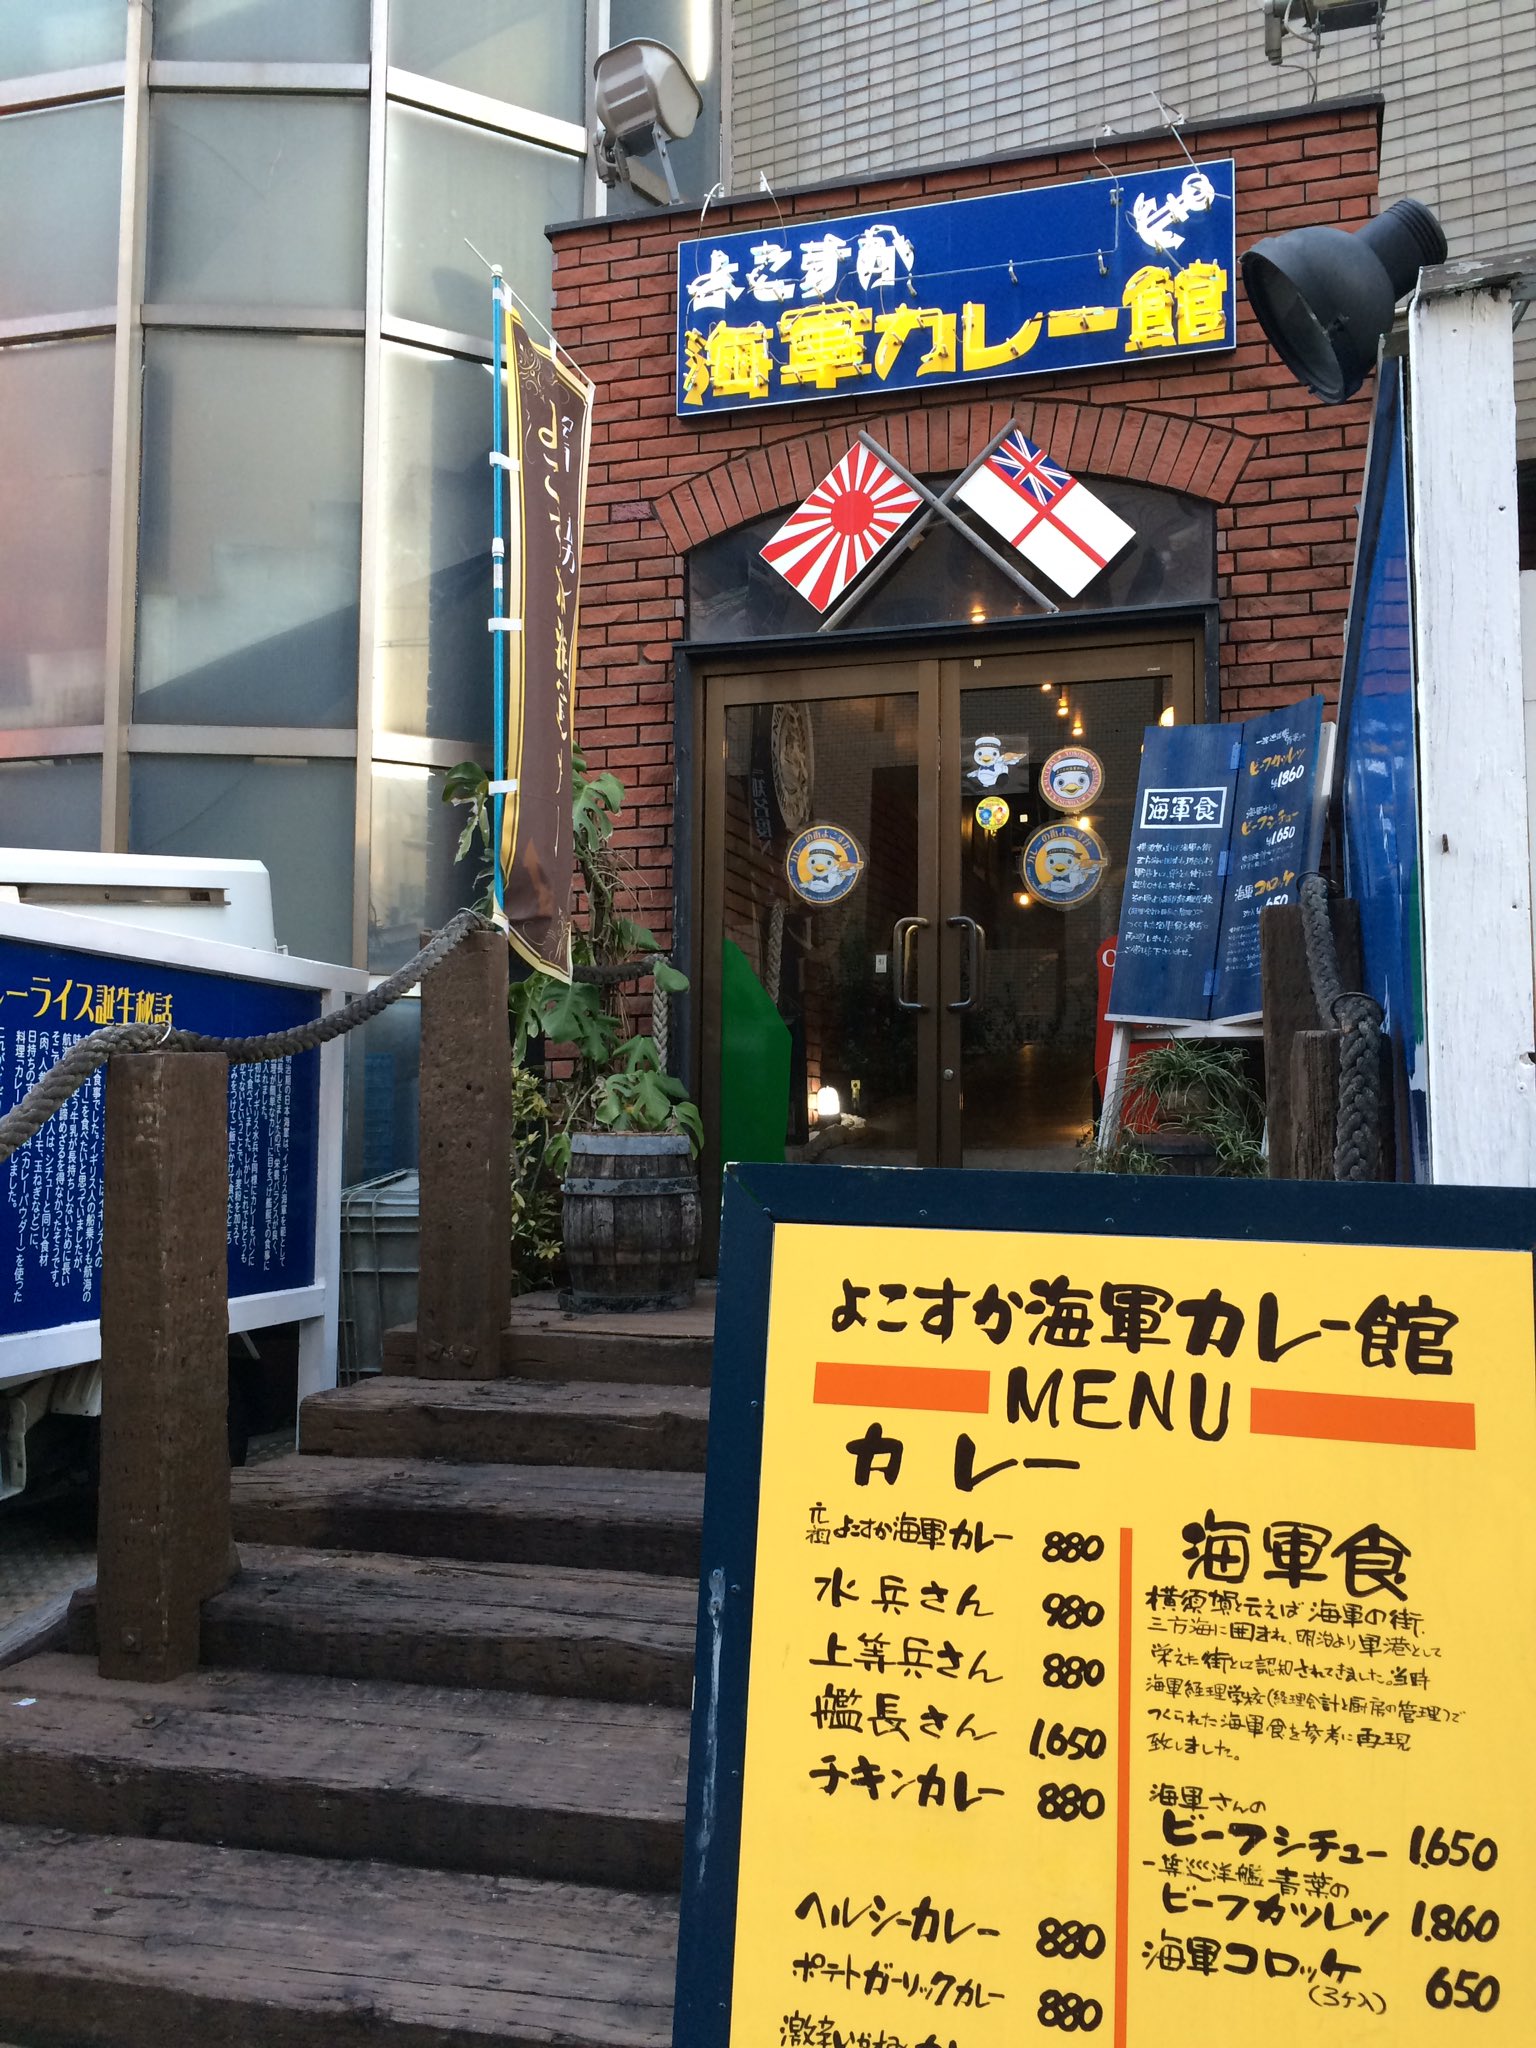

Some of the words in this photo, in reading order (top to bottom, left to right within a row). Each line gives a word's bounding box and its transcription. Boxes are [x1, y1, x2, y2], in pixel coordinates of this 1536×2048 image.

[688, 224, 915, 310] よこすか
[683, 260, 1229, 405] 海軍カレー館
[1148, 796, 1219, 822] 海軍食
[0, 977, 173, 1026] ーライス誕生秘話
[831, 1275, 1459, 1376] よこすか海軍カレー館
[1007, 1366, 1232, 1442] MENU
[845, 1423, 1081, 1492] カレー
[1042, 1531, 1105, 1563] 880
[1182, 1509, 1411, 1601] 海軍食
[814, 1567, 994, 1616] 水兵さん
[1042, 1593, 1105, 1629] 980
[809, 1632, 1003, 1683] 上等兵さん
[1043, 1653, 1105, 1689] 880
[810, 1683, 998, 1742] 艦長さん
[809, 1755, 1005, 1811] チキンカレー
[1037, 1783, 1105, 1822] 880
[1149, 1783, 1267, 1814] 海軍さんの
[1163, 1809, 1388, 1865] ビーフシチュー
[795, 1892, 1001, 1944] ヘルシーカレー
[1036, 1917, 1106, 1960] 880
[1163, 1882, 1390, 1936] ビーフカツレツ
[792, 1952, 1006, 2009] ポテトガーリックカレー
[1037, 1989, 1104, 2032] 880
[1142, 1929, 1362, 1984] 海軍コロッケ
[1425, 1966, 1501, 2013] 650
